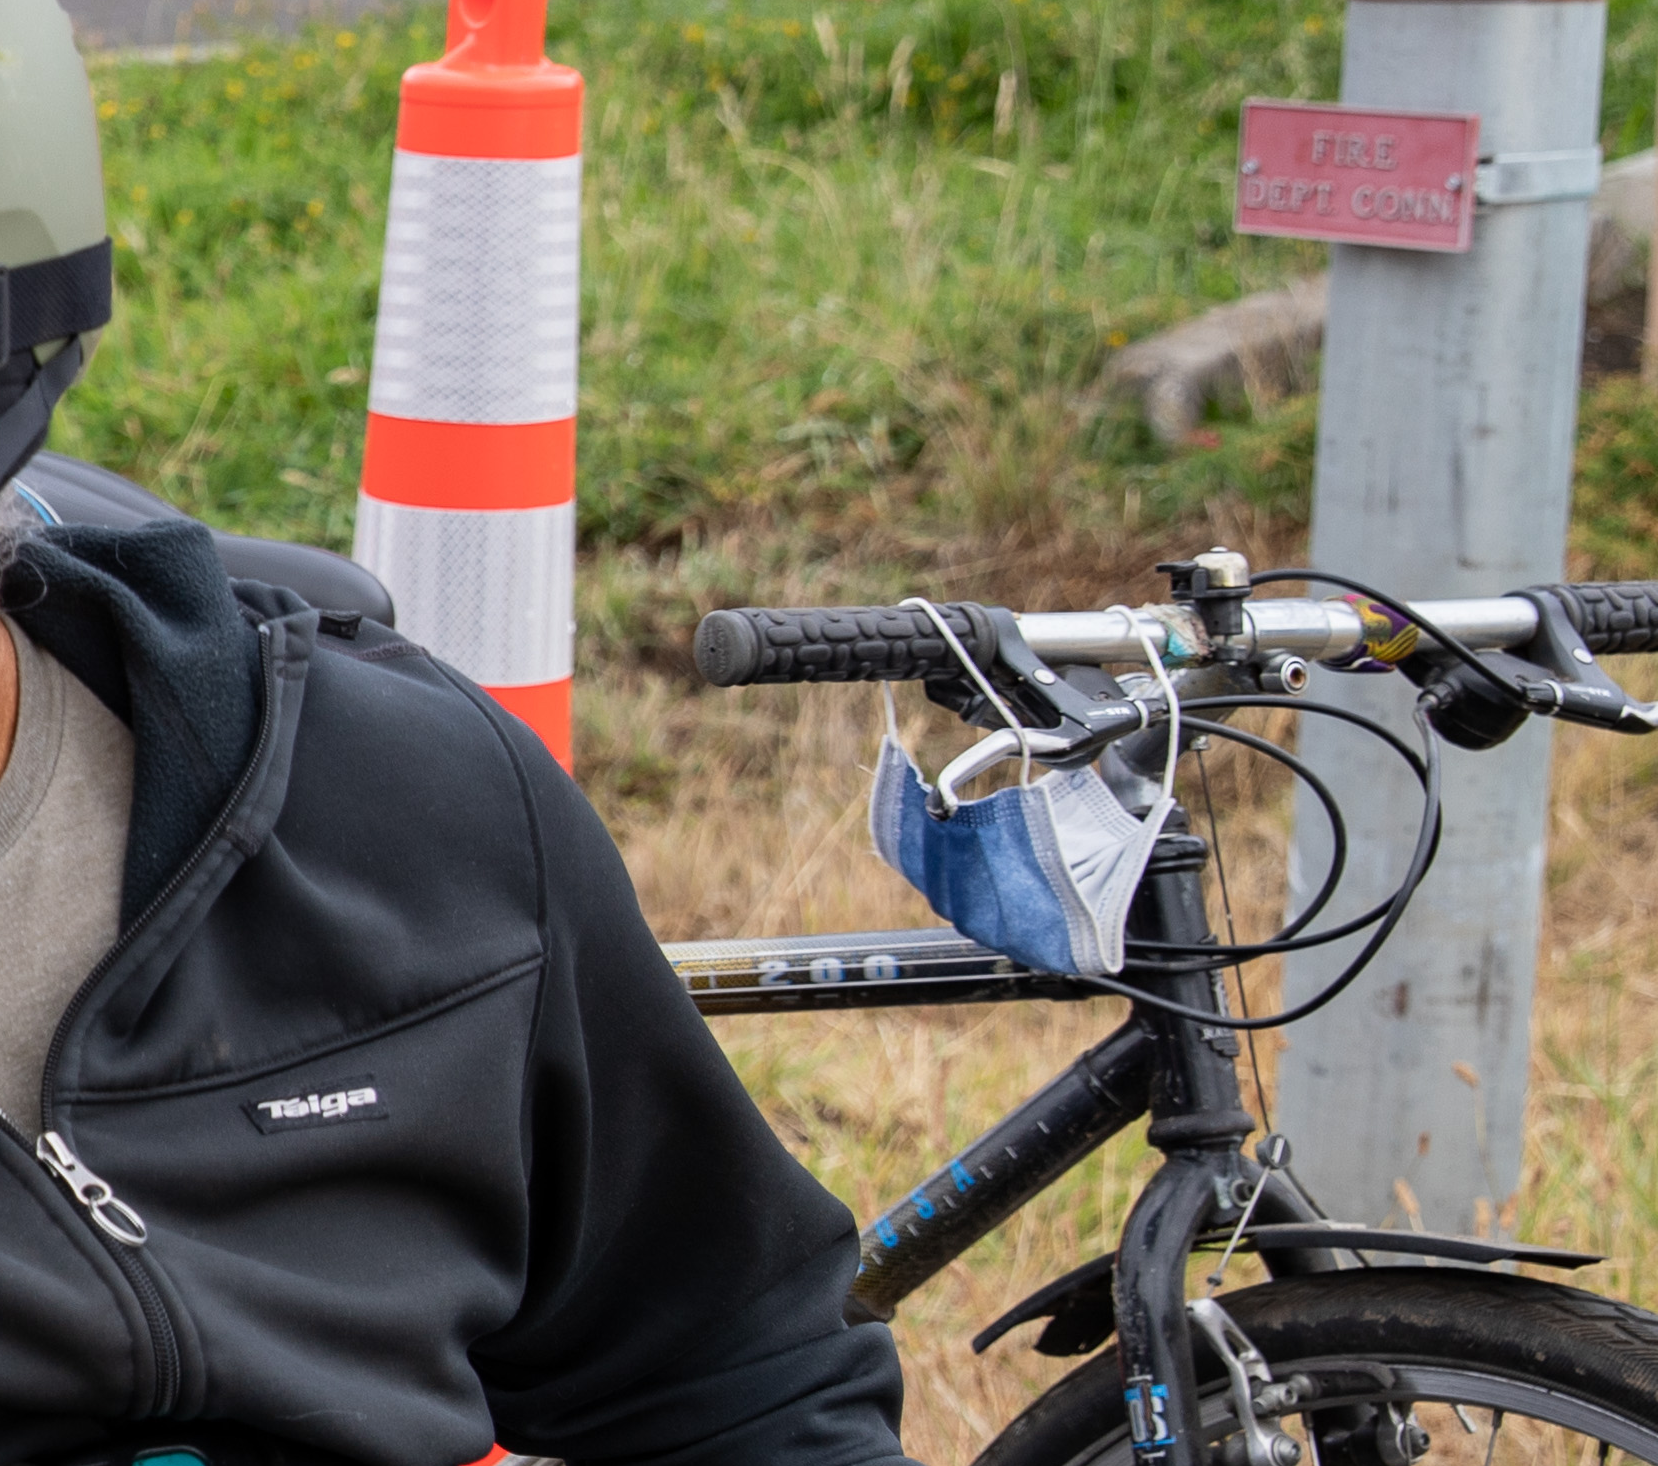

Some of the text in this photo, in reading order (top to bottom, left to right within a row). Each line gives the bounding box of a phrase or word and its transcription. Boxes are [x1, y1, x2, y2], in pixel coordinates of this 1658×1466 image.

[1311, 131, 1398, 171] FIRE
[758, 954, 901, 987] 200
[257, 1087, 377, 1119] Taiga
